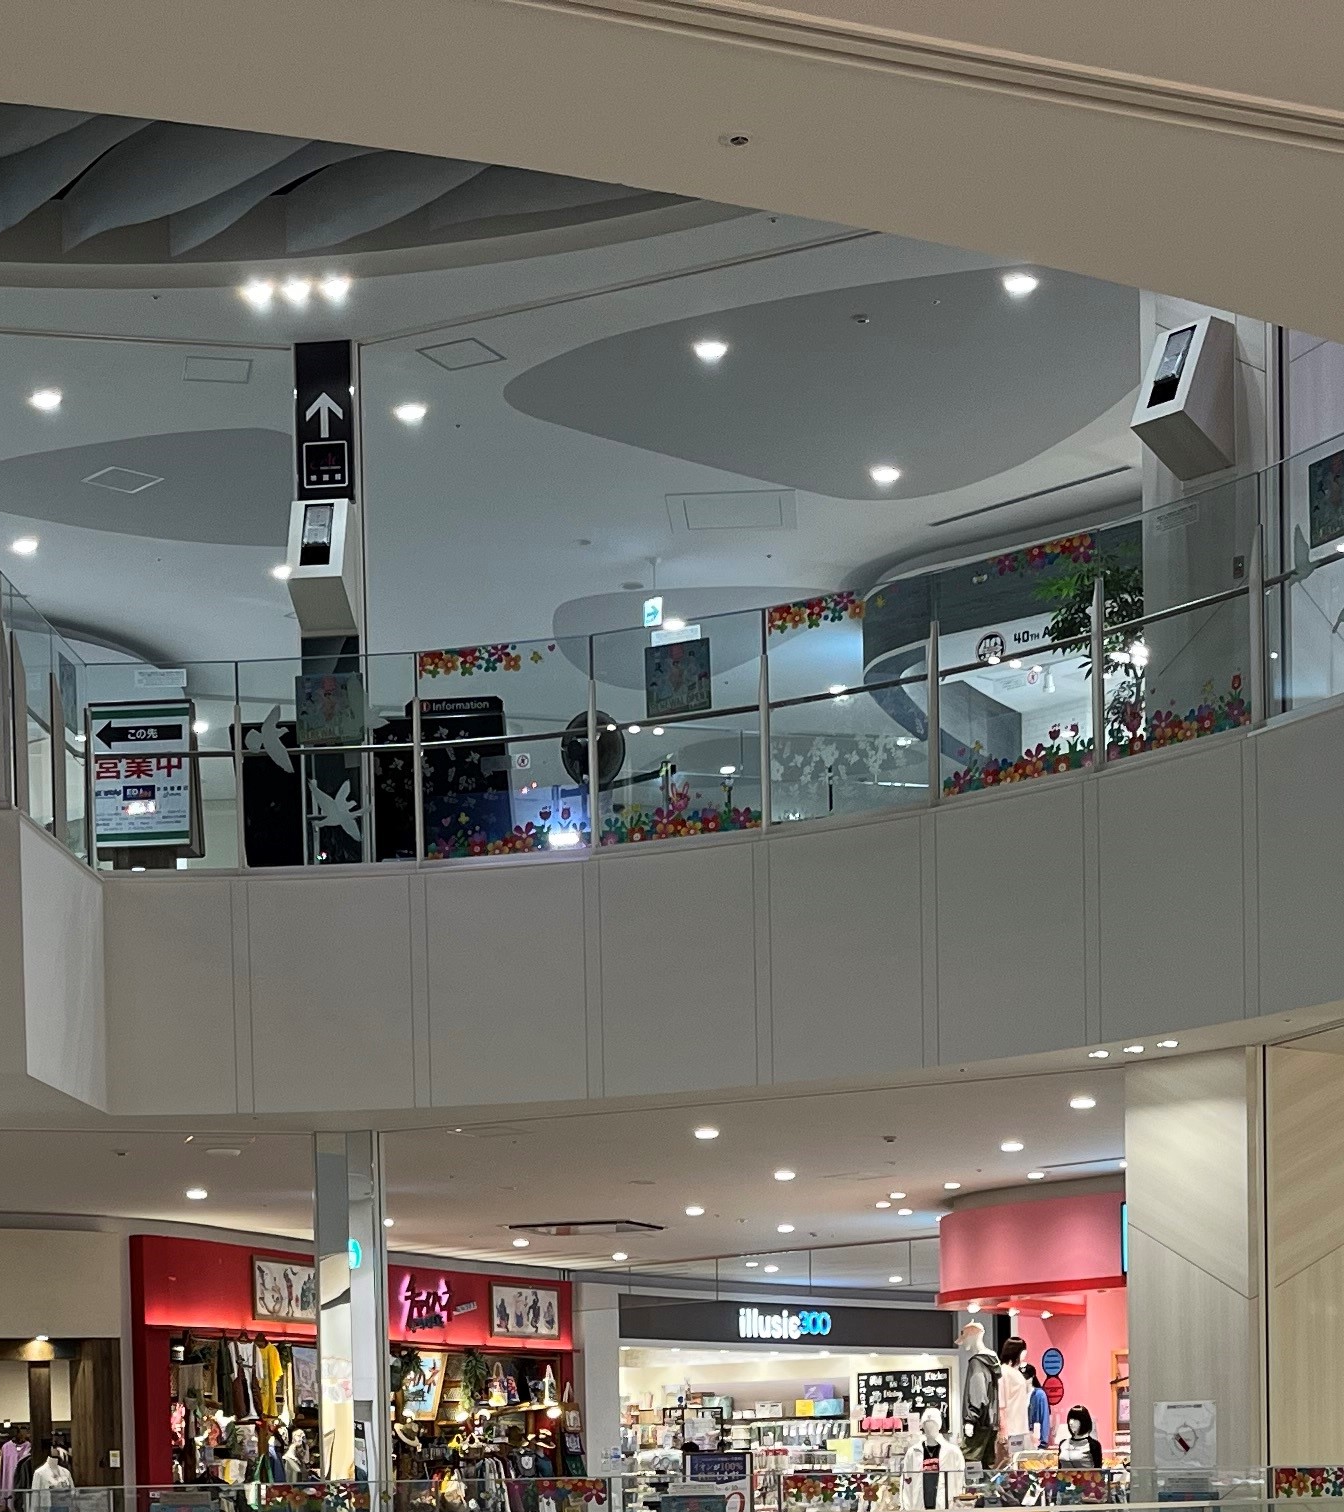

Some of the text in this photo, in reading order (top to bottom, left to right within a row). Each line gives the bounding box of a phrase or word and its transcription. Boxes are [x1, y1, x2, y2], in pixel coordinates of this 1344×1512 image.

[433, 700, 490, 711] Information
[127, 728, 158, 740] この先
